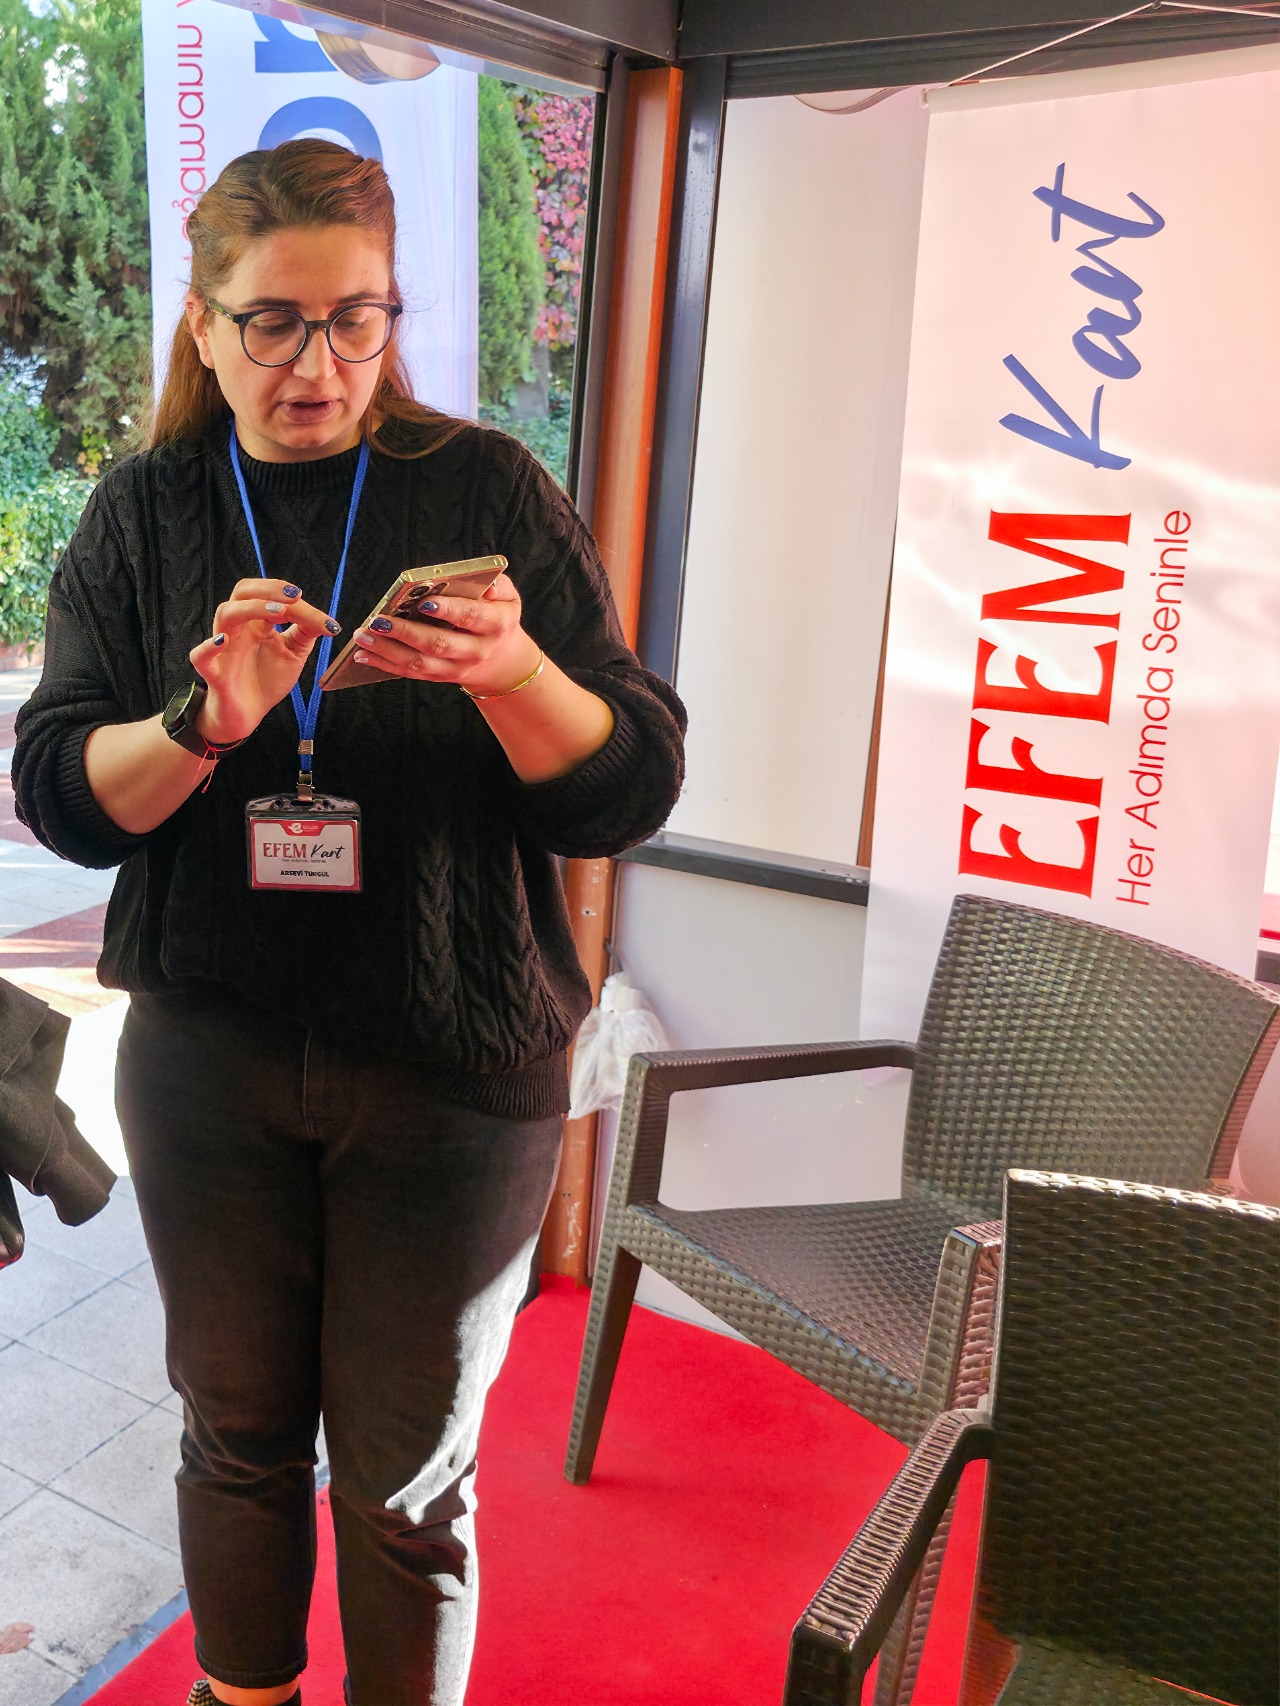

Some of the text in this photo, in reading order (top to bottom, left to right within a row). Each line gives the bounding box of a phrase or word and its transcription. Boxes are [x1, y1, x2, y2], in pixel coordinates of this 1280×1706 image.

[957, 162, 1165, 900] EFEM Kart
[1115, 509, 1193, 907] Her Adımda Seninle
[263, 842, 345, 859] EFEM Kart
